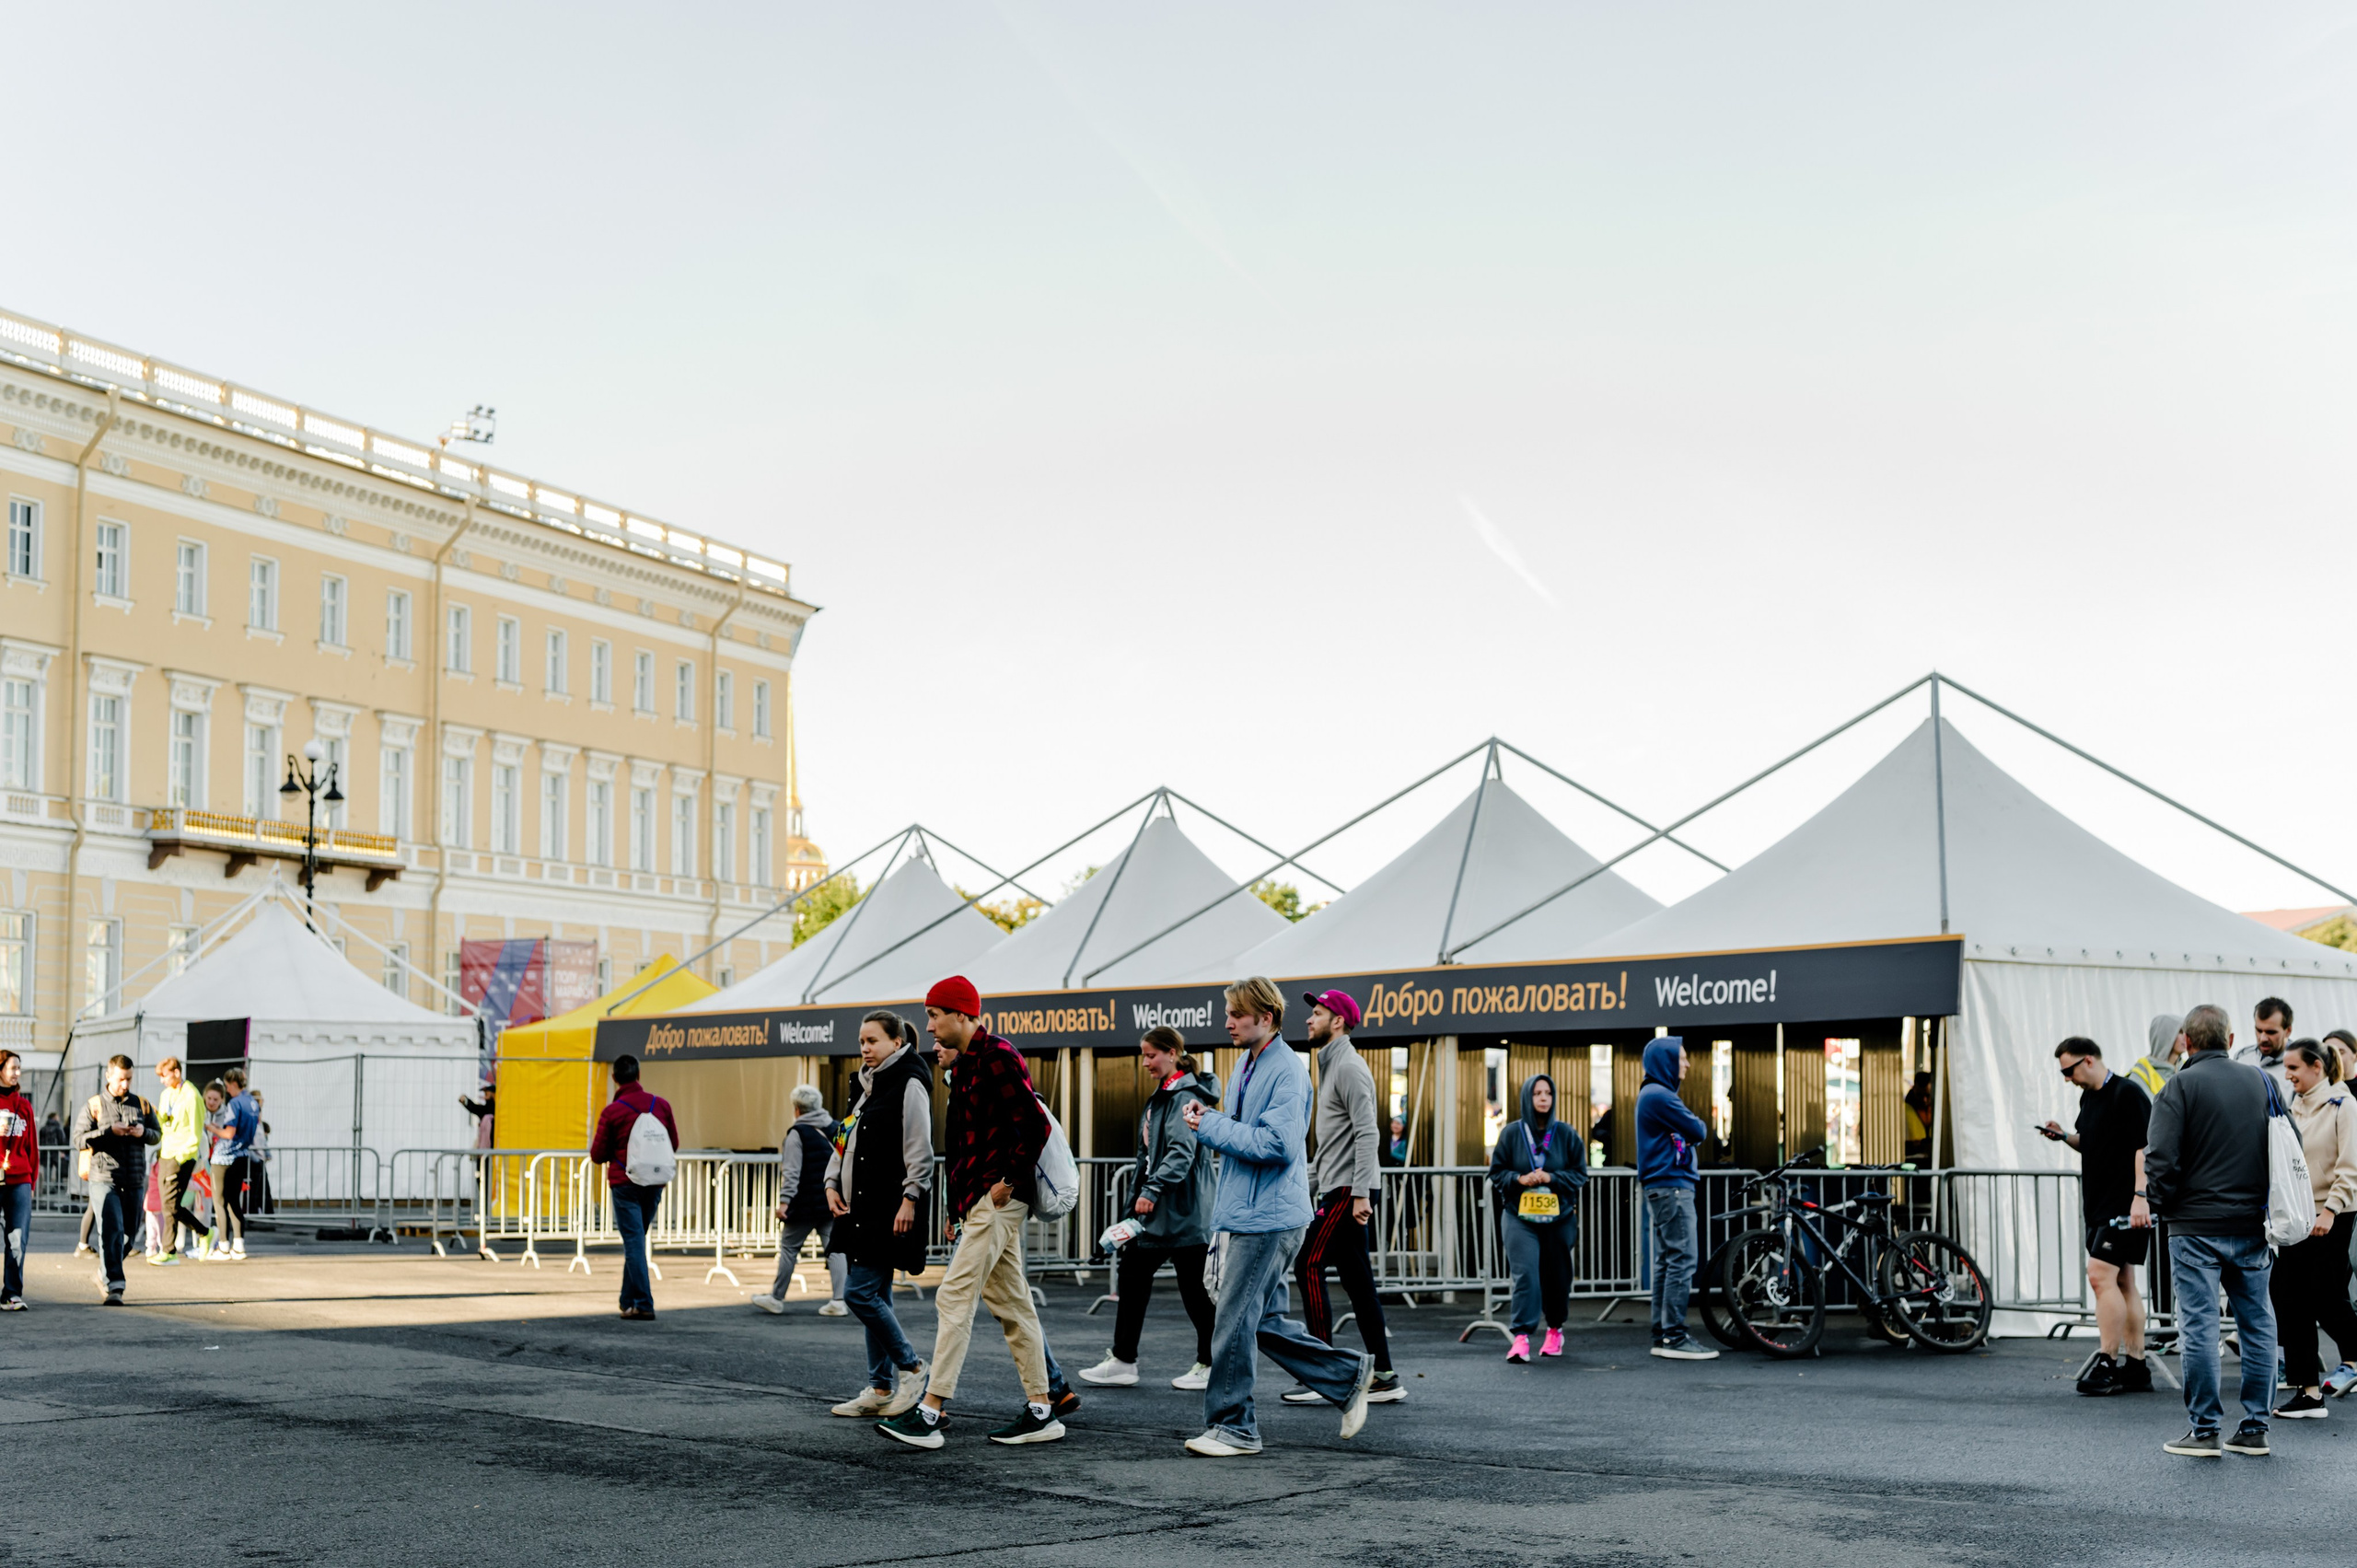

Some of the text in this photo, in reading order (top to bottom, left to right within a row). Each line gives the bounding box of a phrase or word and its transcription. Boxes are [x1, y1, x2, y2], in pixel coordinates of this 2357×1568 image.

[1363, 970, 1628, 1028] Добро пожаловать!
[1655, 969, 1777, 1008] Welcome!
[780, 1019, 834, 1044] Welcome!
[997, 998, 1116, 1035] пожаловать!
[1132, 1000, 1213, 1029] Welcome!
[644, 1018, 770, 1056] Добро пожаловать!
[1523, 1196, 1558, 1208] 11538
